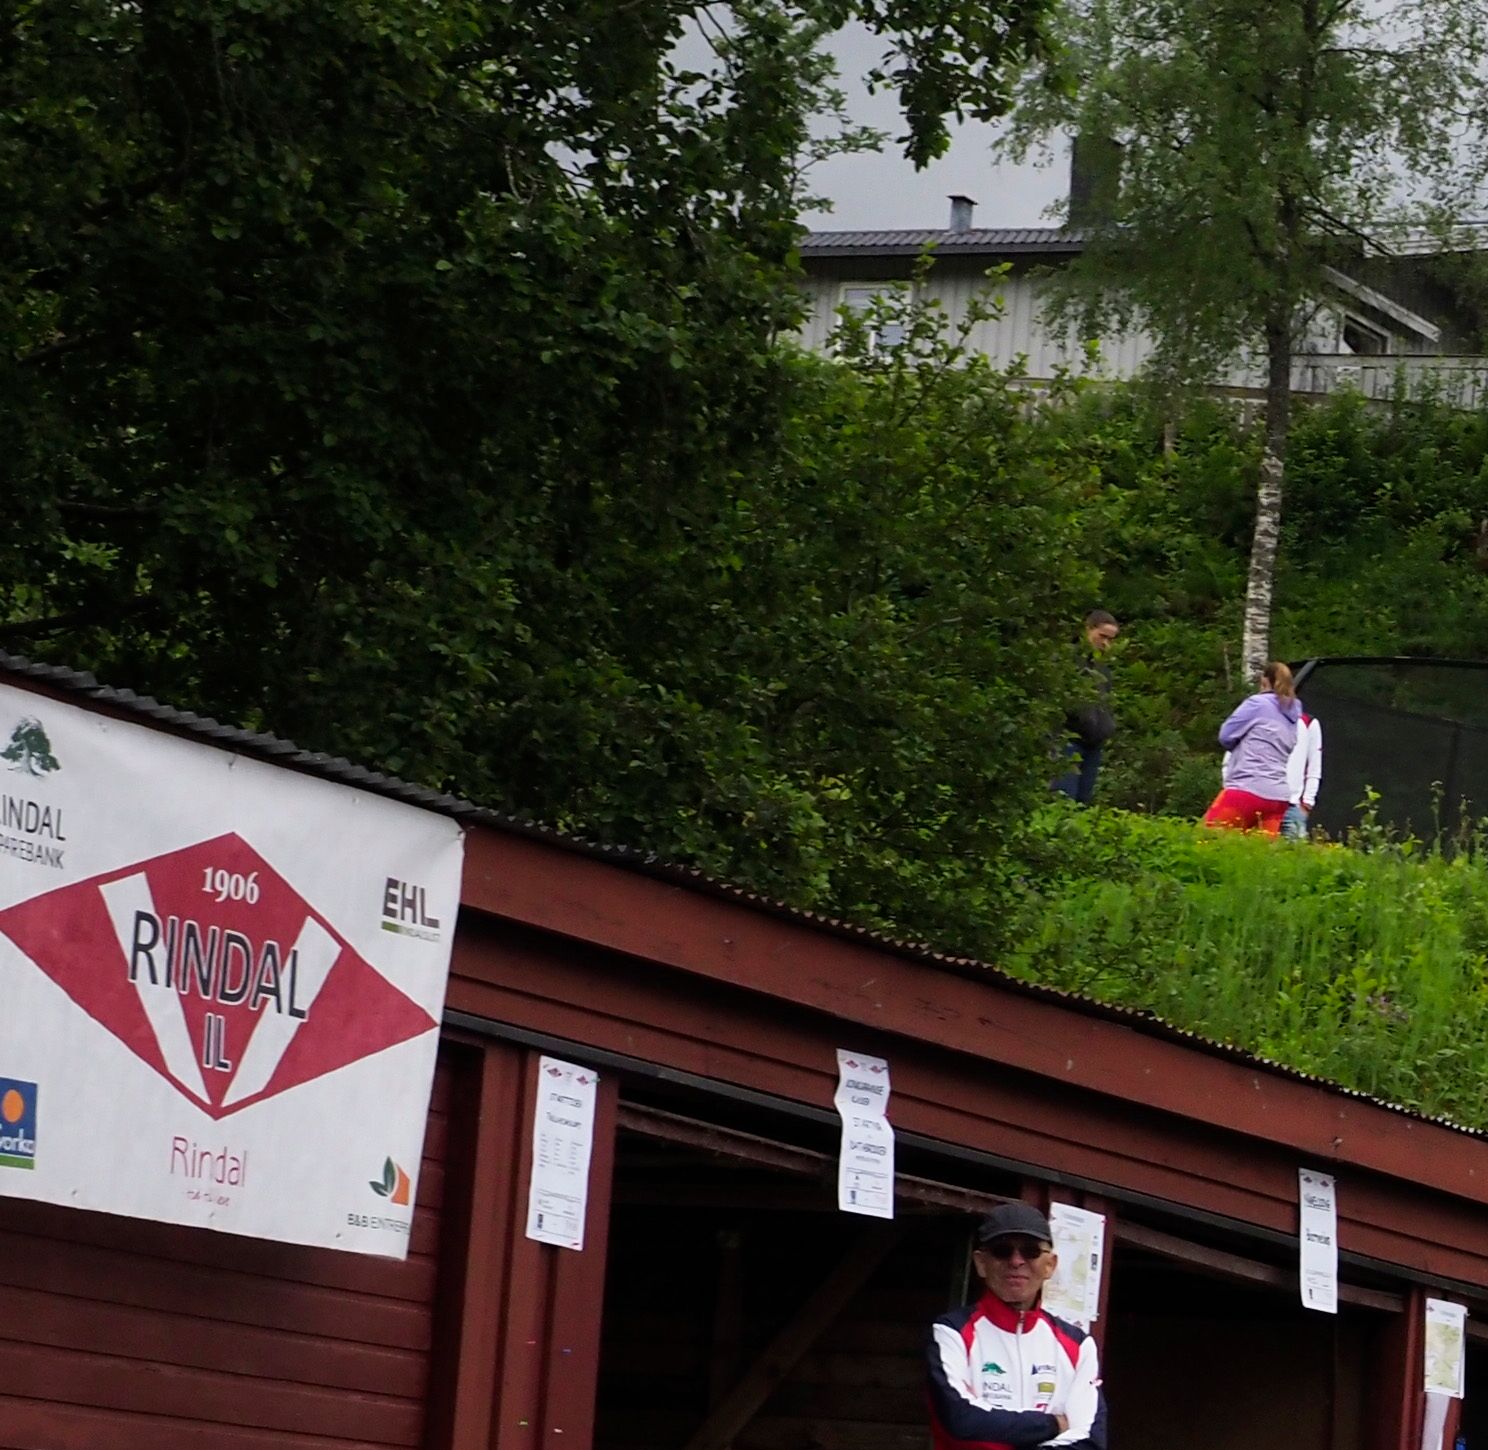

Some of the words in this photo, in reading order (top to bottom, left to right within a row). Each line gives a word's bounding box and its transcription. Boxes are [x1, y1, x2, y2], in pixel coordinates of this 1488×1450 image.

[0, 794, 66, 841] INDAL
[201, 867, 260, 905] 1906
[382, 877, 439, 929] EHL
[128, 909, 309, 1020] RINDAL
[203, 1012, 231, 1073] IL
[170, 1136, 248, 1188] Rindal
